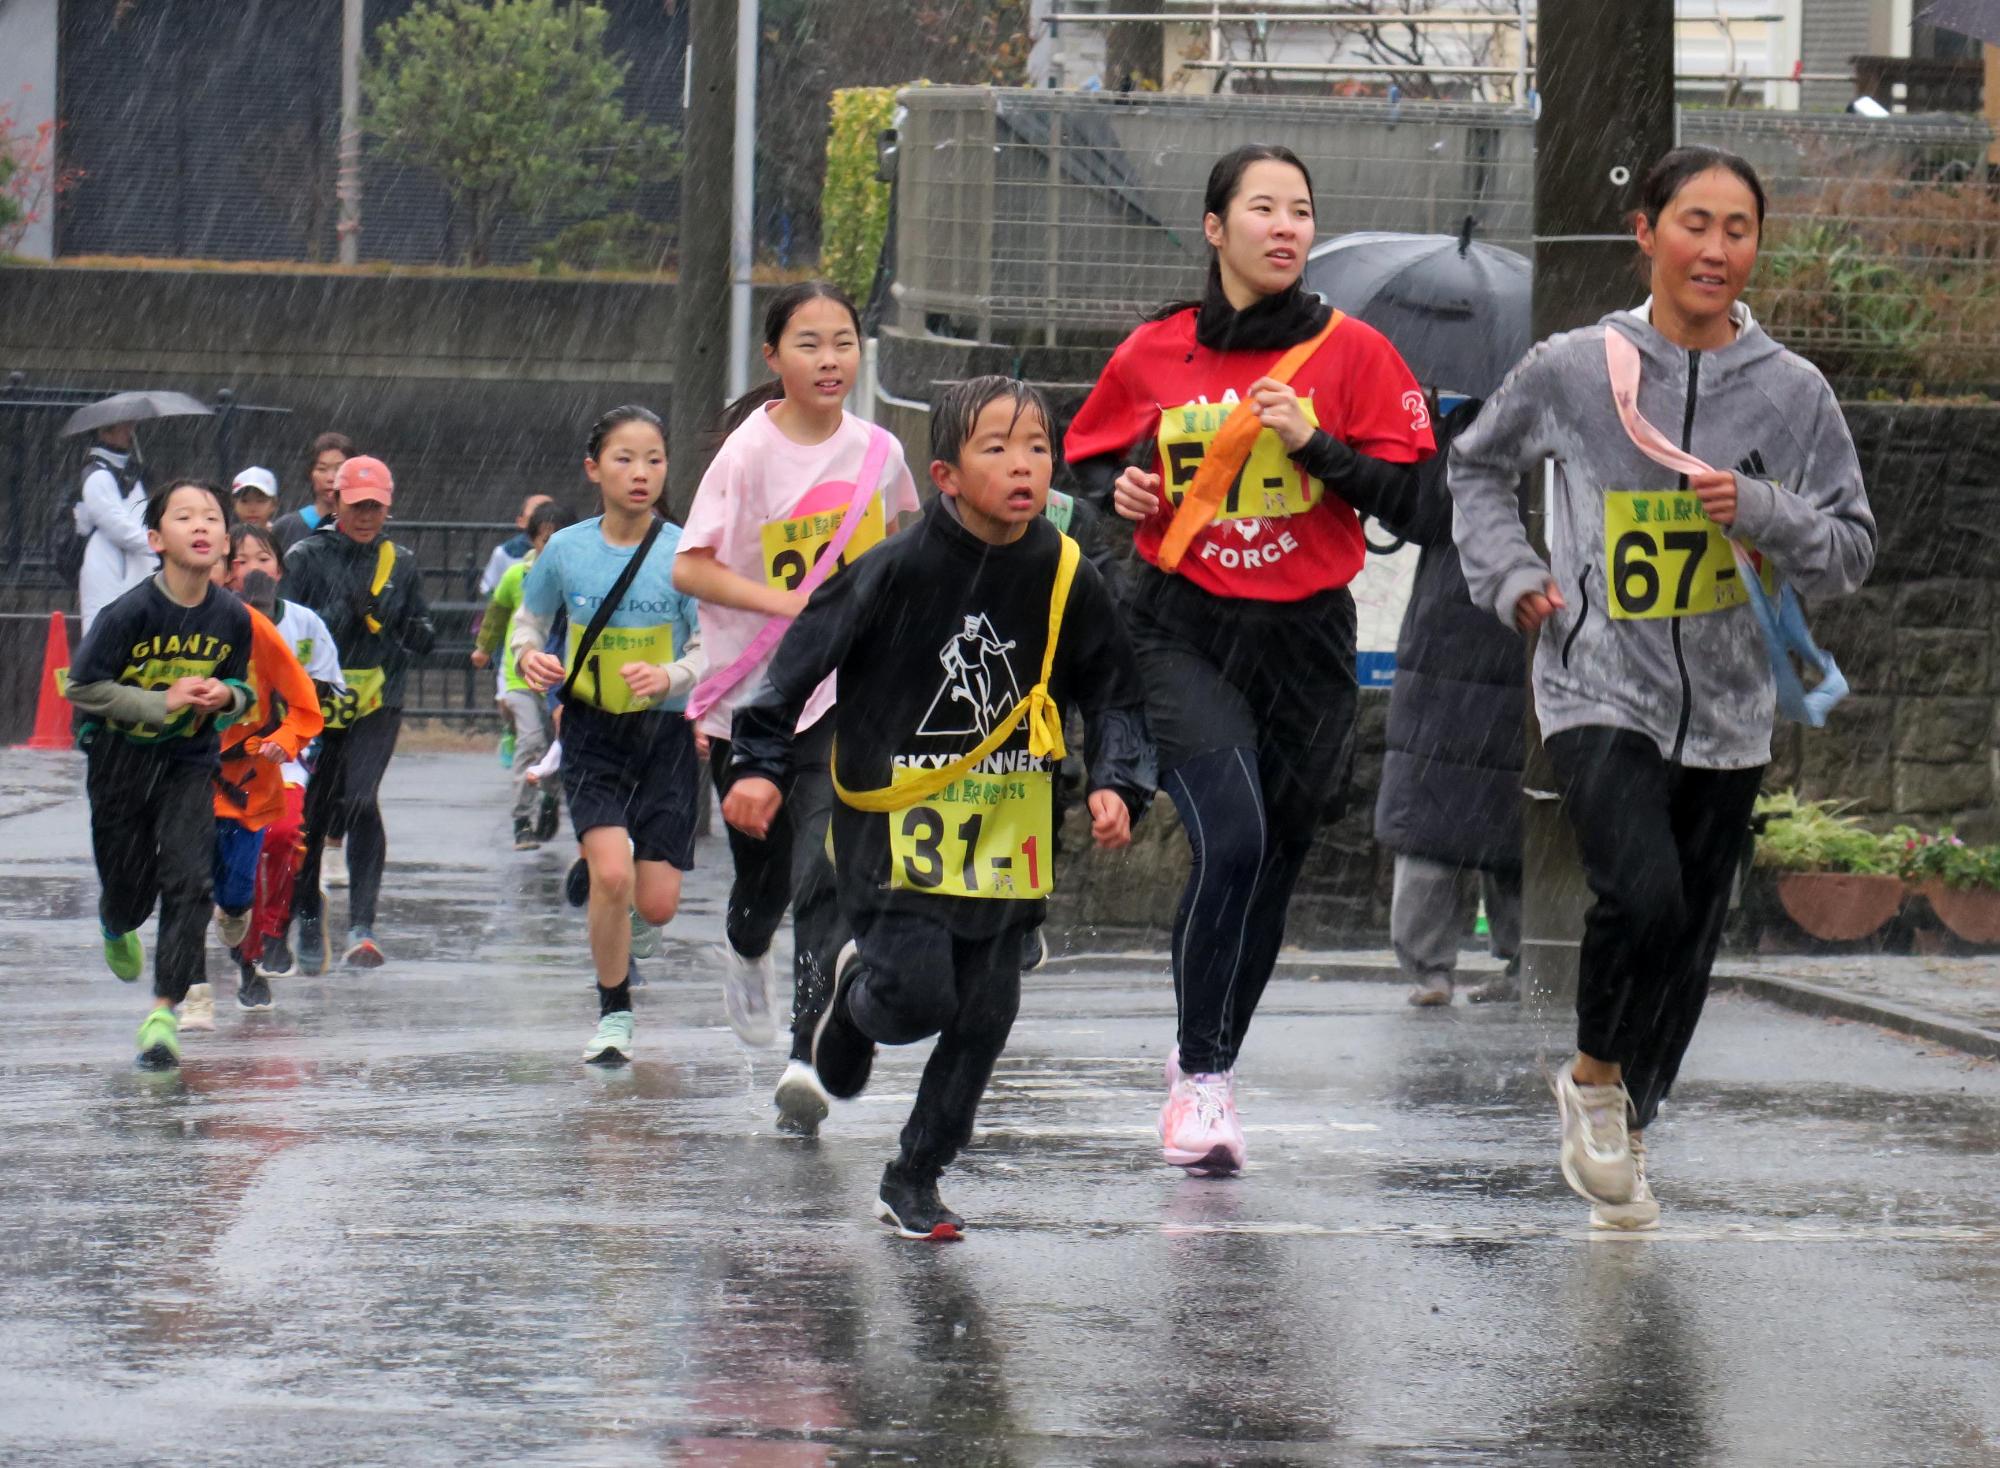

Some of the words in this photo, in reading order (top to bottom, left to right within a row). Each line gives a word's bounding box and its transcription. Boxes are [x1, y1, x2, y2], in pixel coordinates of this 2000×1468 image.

[1402, 391, 1430, 431] 3
[1201, 531, 1298, 568] FORCE
[132, 633, 232, 662] GIANTS
[588, 655, 601, 706] 1
[902, 807, 1039, 890] 31-1
